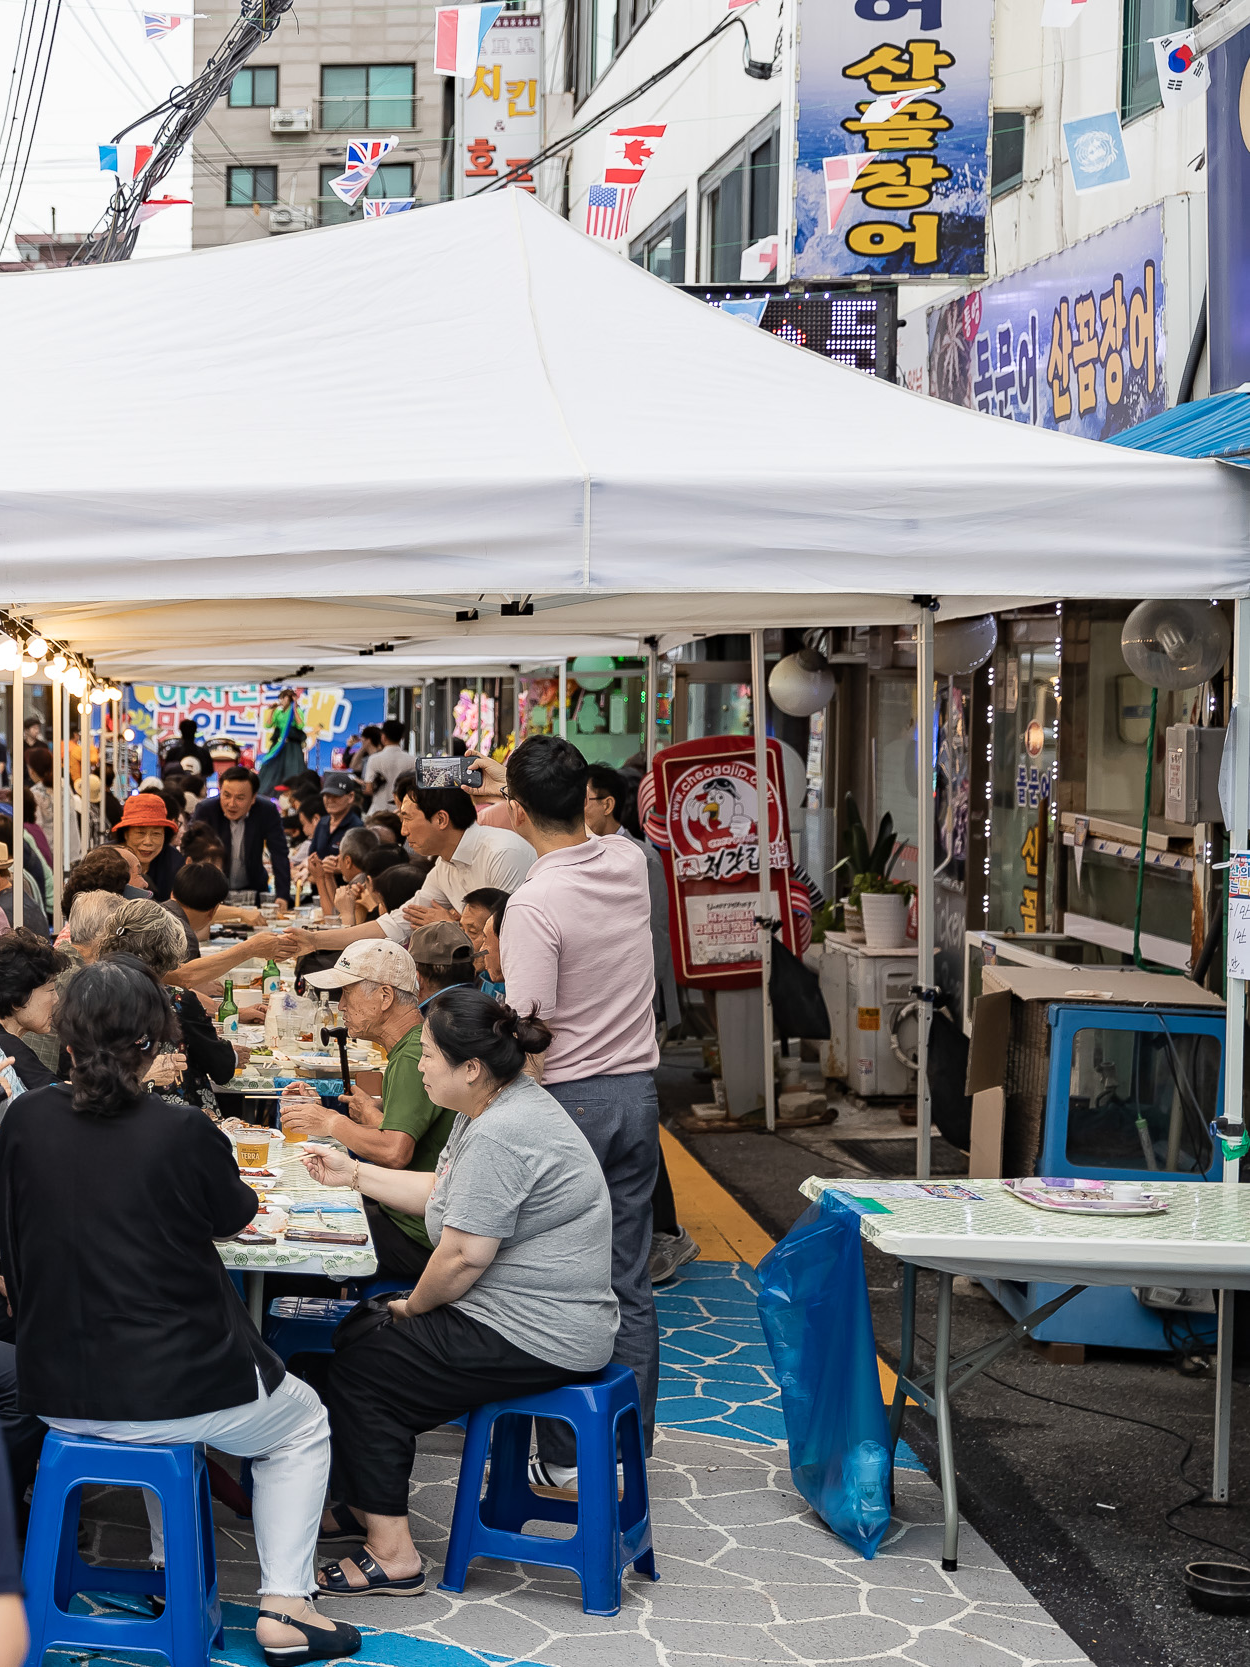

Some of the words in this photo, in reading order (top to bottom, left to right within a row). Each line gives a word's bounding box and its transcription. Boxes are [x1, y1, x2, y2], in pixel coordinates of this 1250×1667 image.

[467, 65, 538, 118] 치킨
[494, 120, 506, 132] &
[974, 309, 1039, 426] 돌문어
[703, 846, 760, 878] 처갓집
[241, 1152, 260, 1160] TERRA
